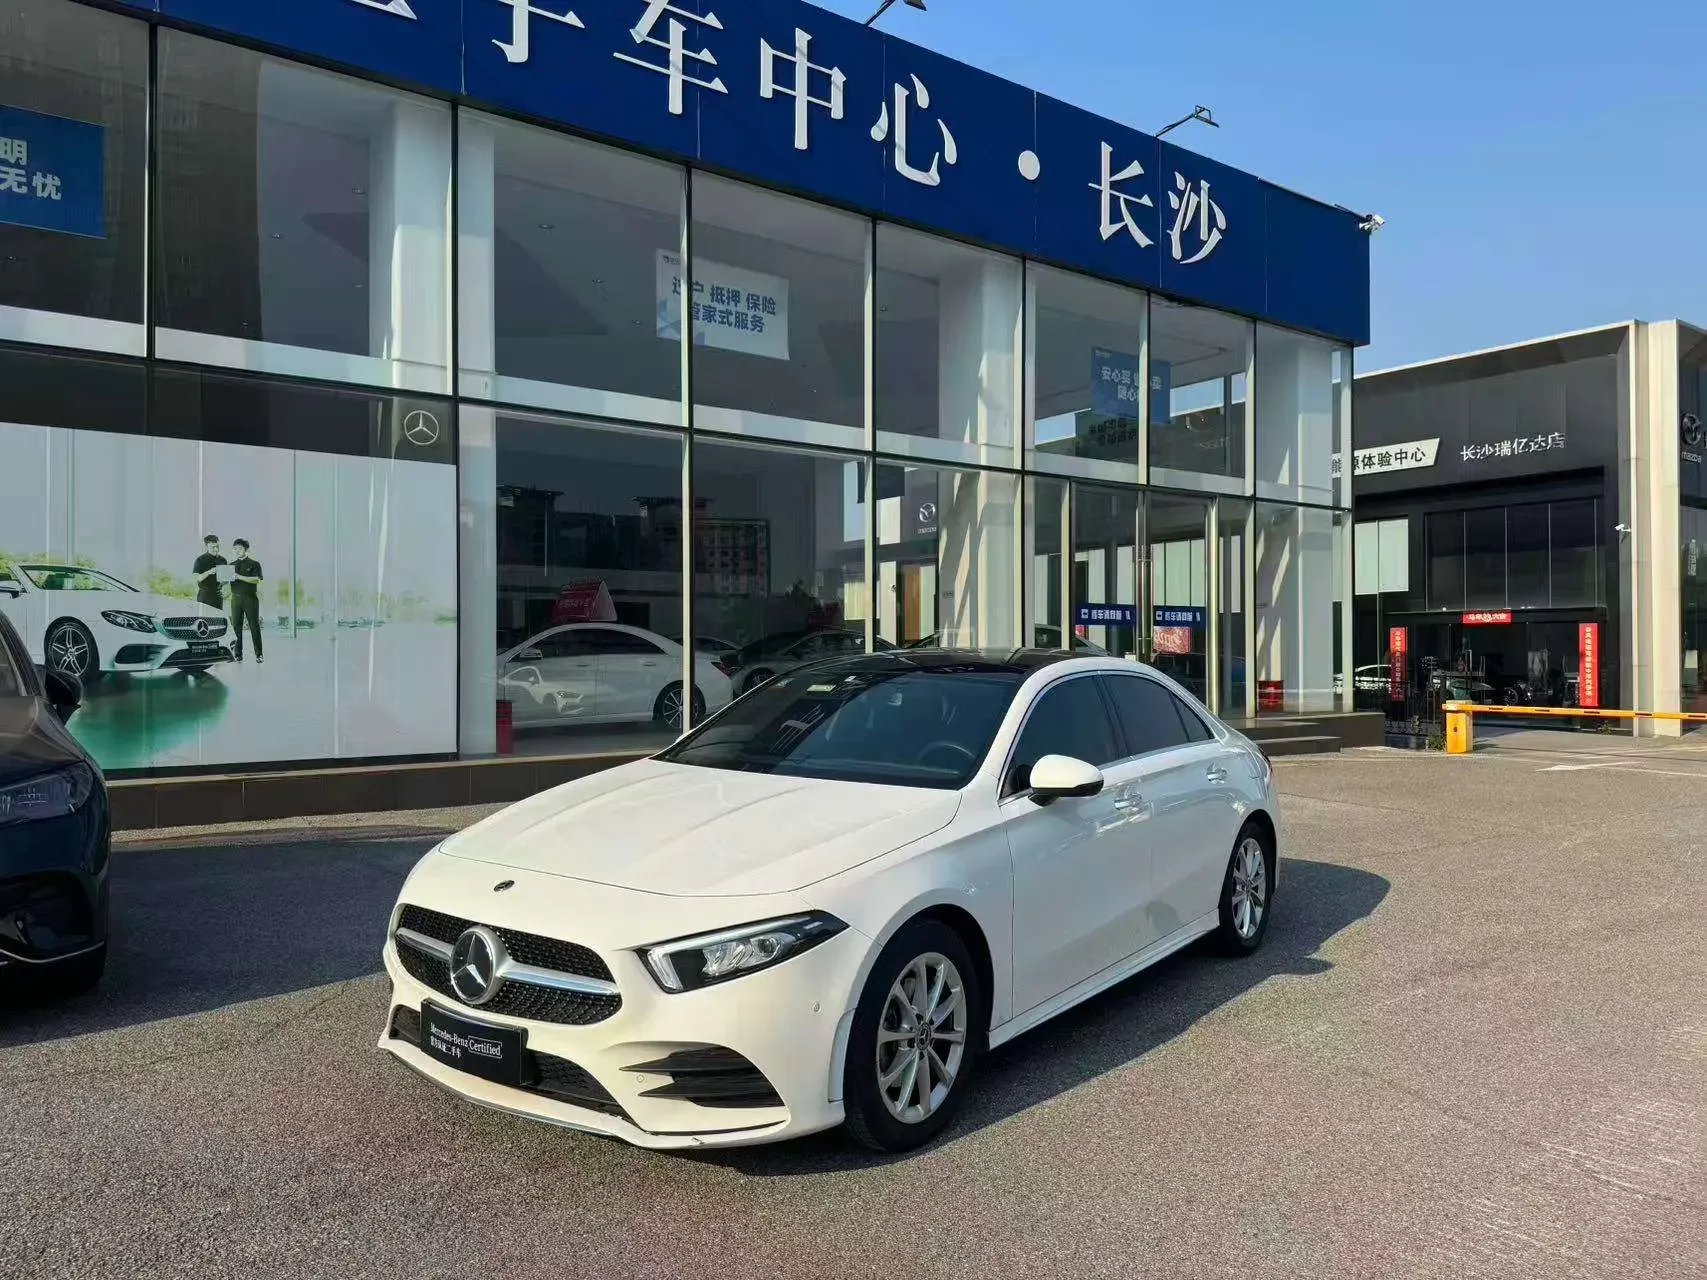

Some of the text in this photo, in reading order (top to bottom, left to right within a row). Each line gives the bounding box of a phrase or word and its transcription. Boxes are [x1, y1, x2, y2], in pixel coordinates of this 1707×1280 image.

[0, 166, 62, 200] 无忧
[710, 285, 741, 307] 抵押
[746, 293, 776, 315] 保险
[430, 1022, 502, 1056] Mercedes-Benz Certified
